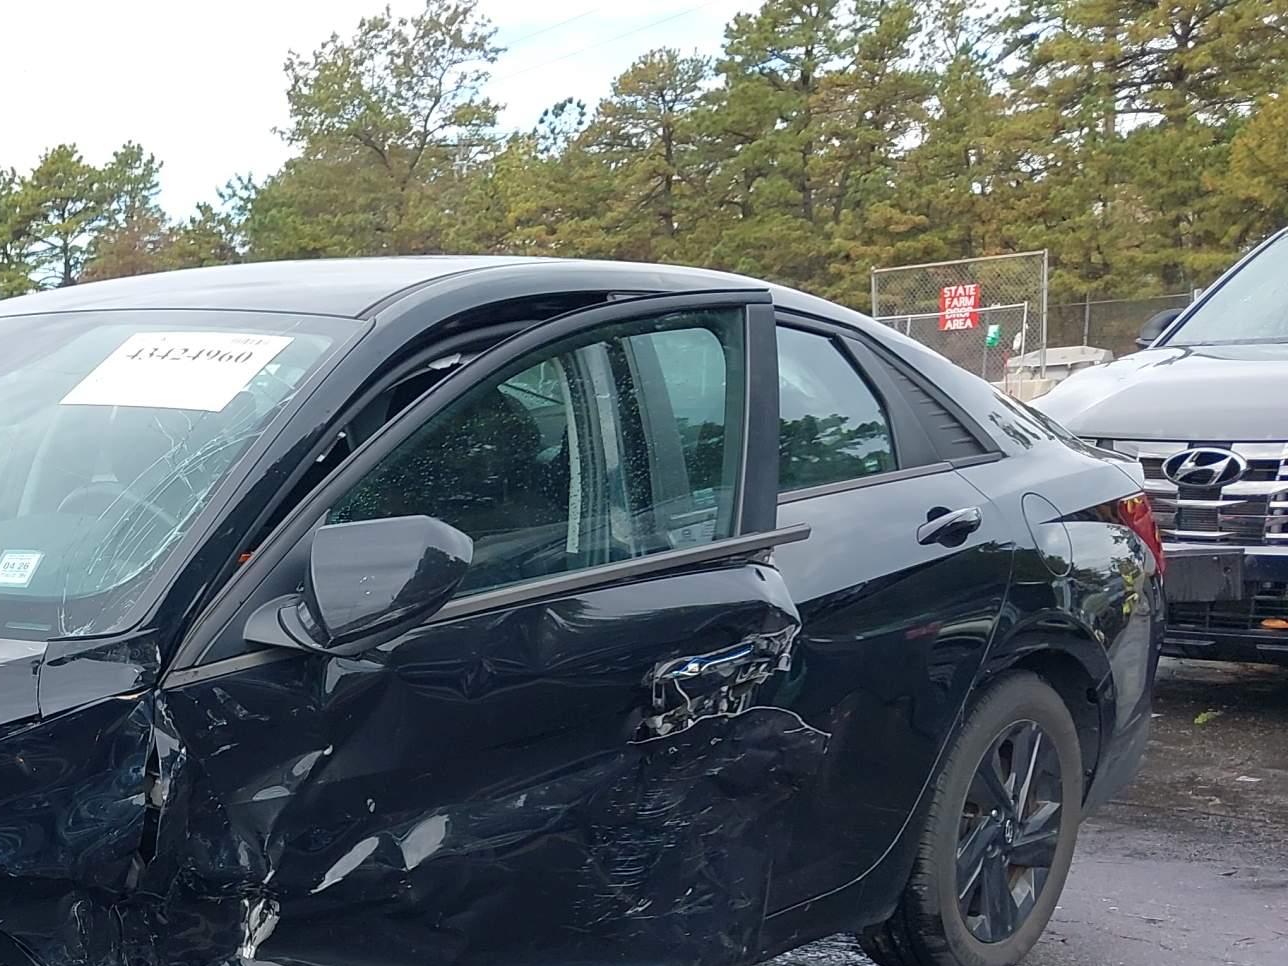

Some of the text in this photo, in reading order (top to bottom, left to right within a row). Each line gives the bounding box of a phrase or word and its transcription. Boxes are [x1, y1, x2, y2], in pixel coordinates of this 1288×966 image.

[943, 284, 976, 297] STATE
[945, 296, 974, 308] FARM
[943, 319, 973, 330] AREA
[126, 347, 253, 363] 43424960
